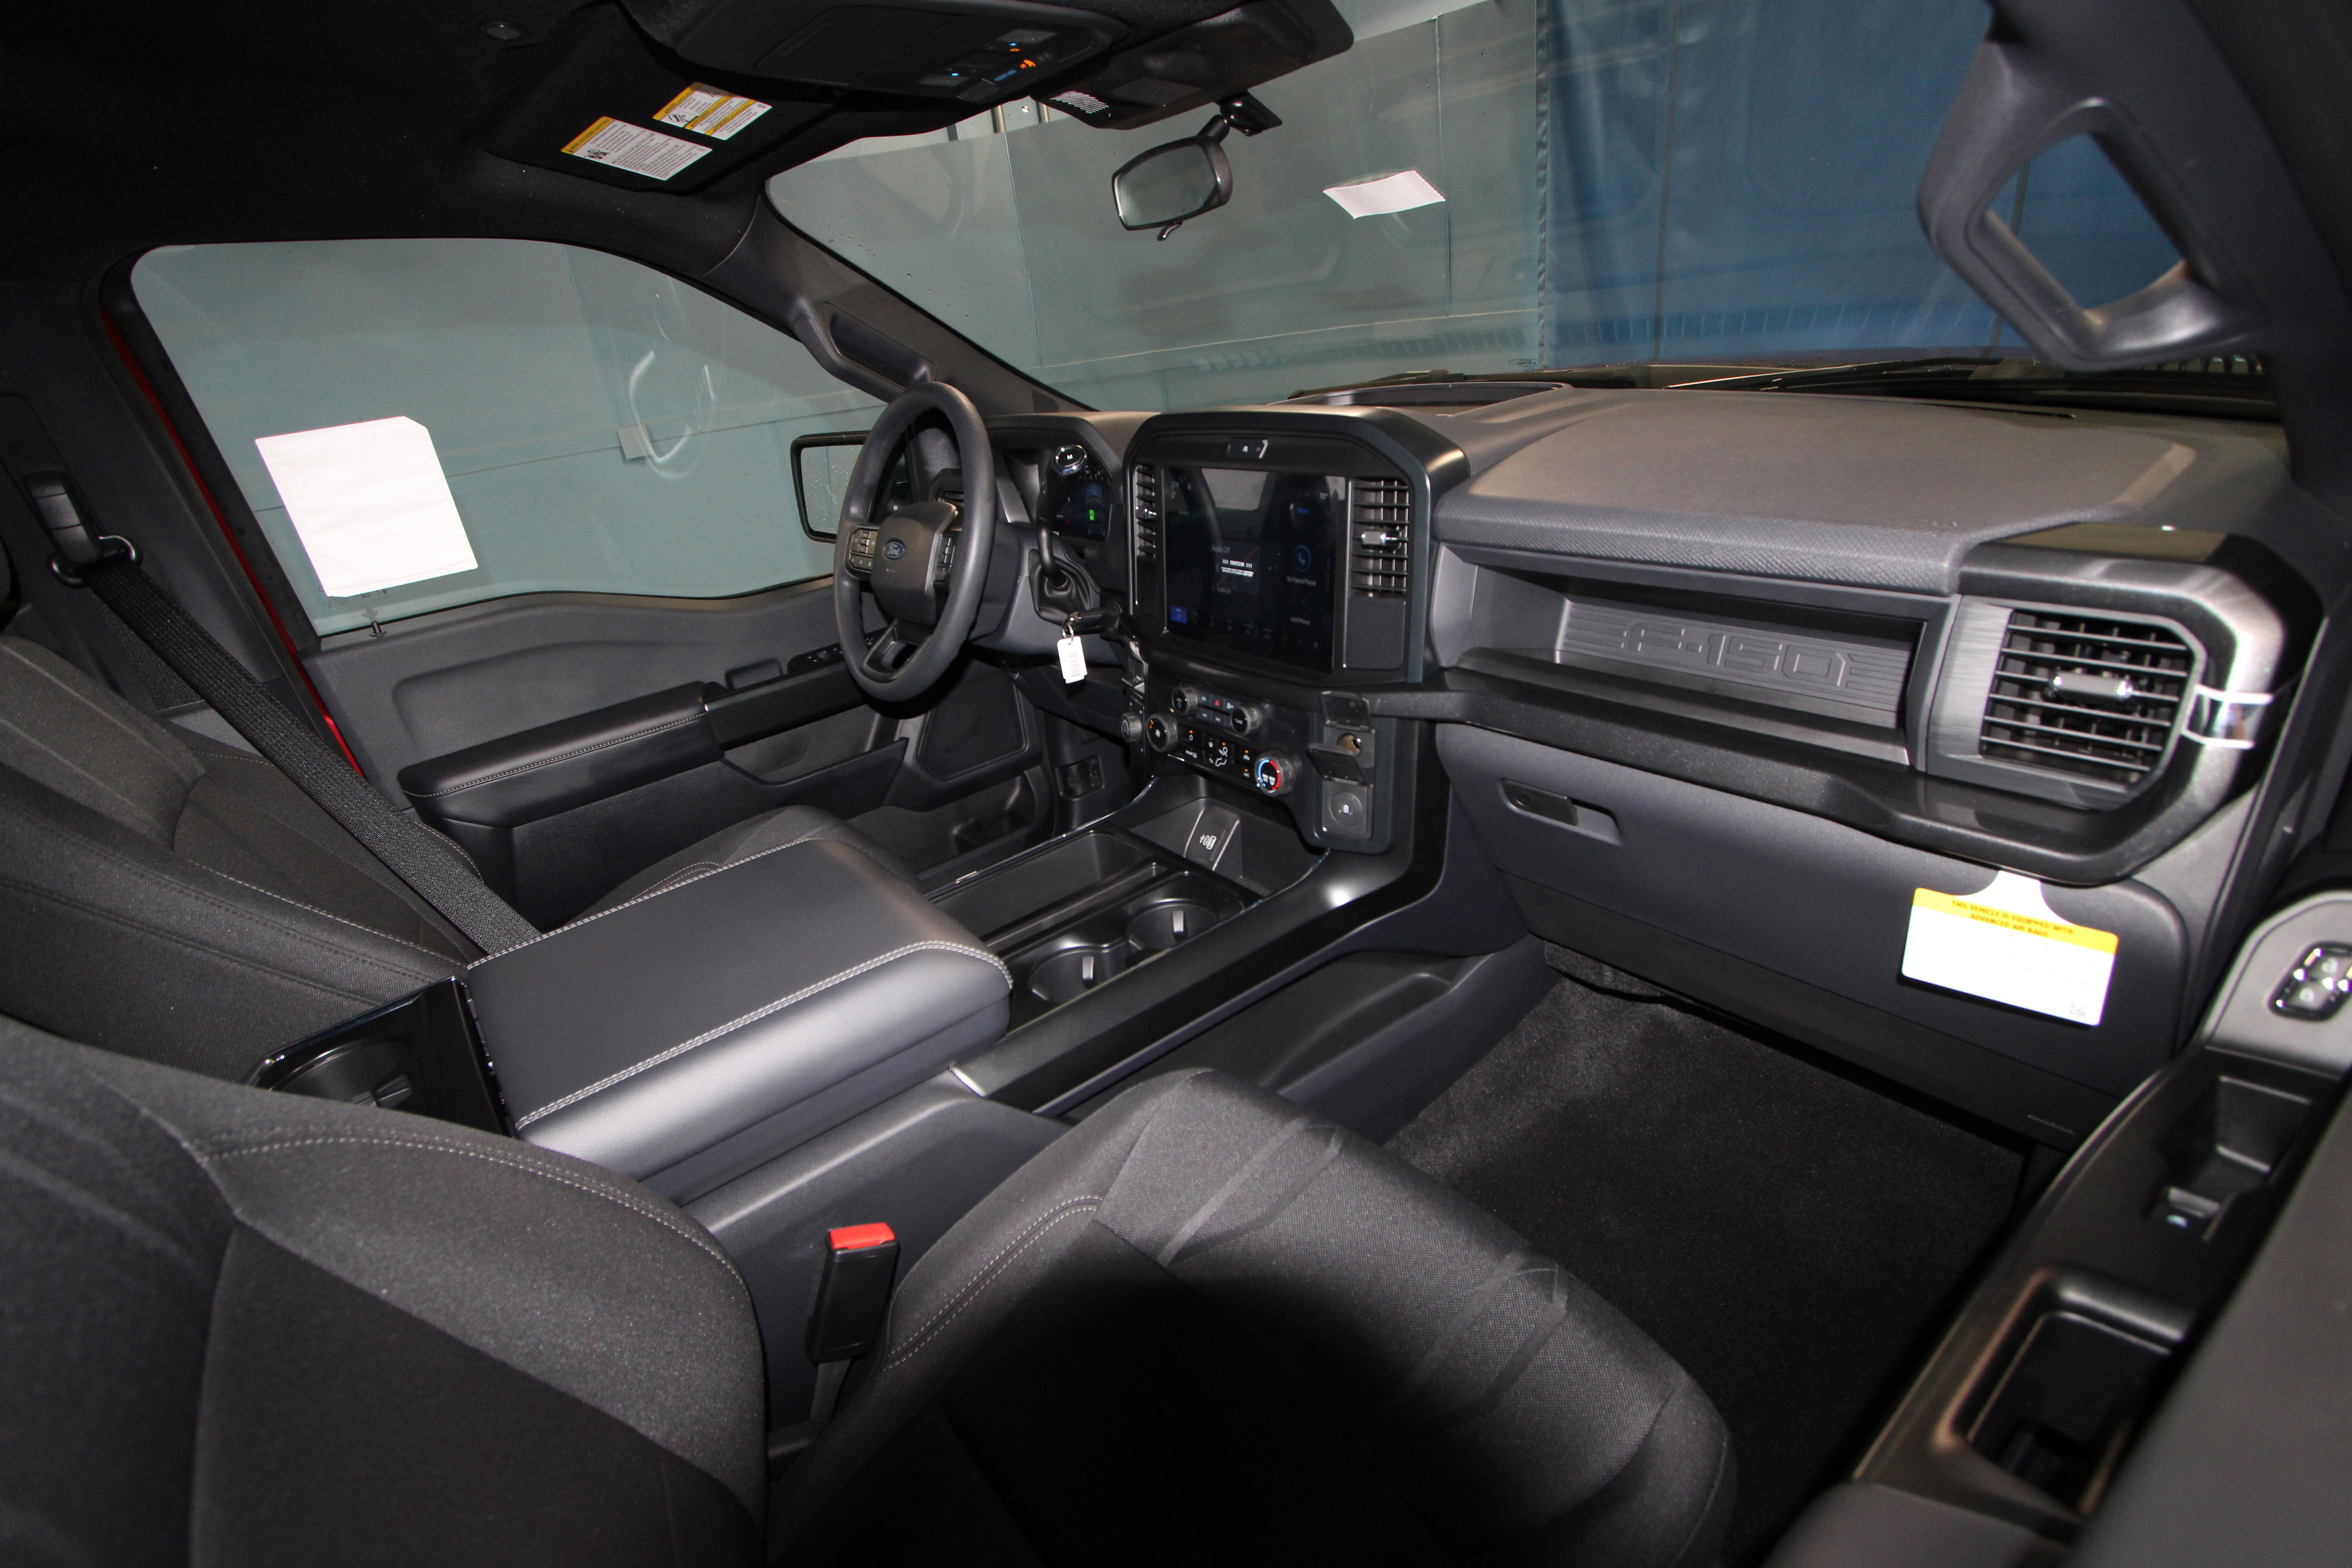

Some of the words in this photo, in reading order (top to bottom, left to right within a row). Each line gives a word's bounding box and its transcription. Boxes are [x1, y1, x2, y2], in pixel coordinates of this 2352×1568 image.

[1628, 621, 1846, 687] F-150
[1951, 900, 1967, 909] THIS
[1970, 905, 2000, 917] VEHICLE
[2012, 915, 2050, 929] EQUIPPED
[2052, 925, 2074, 935] WITH
[1970, 913, 2010, 928] ADVANCED
[2027, 927, 2049, 937] BAGS
